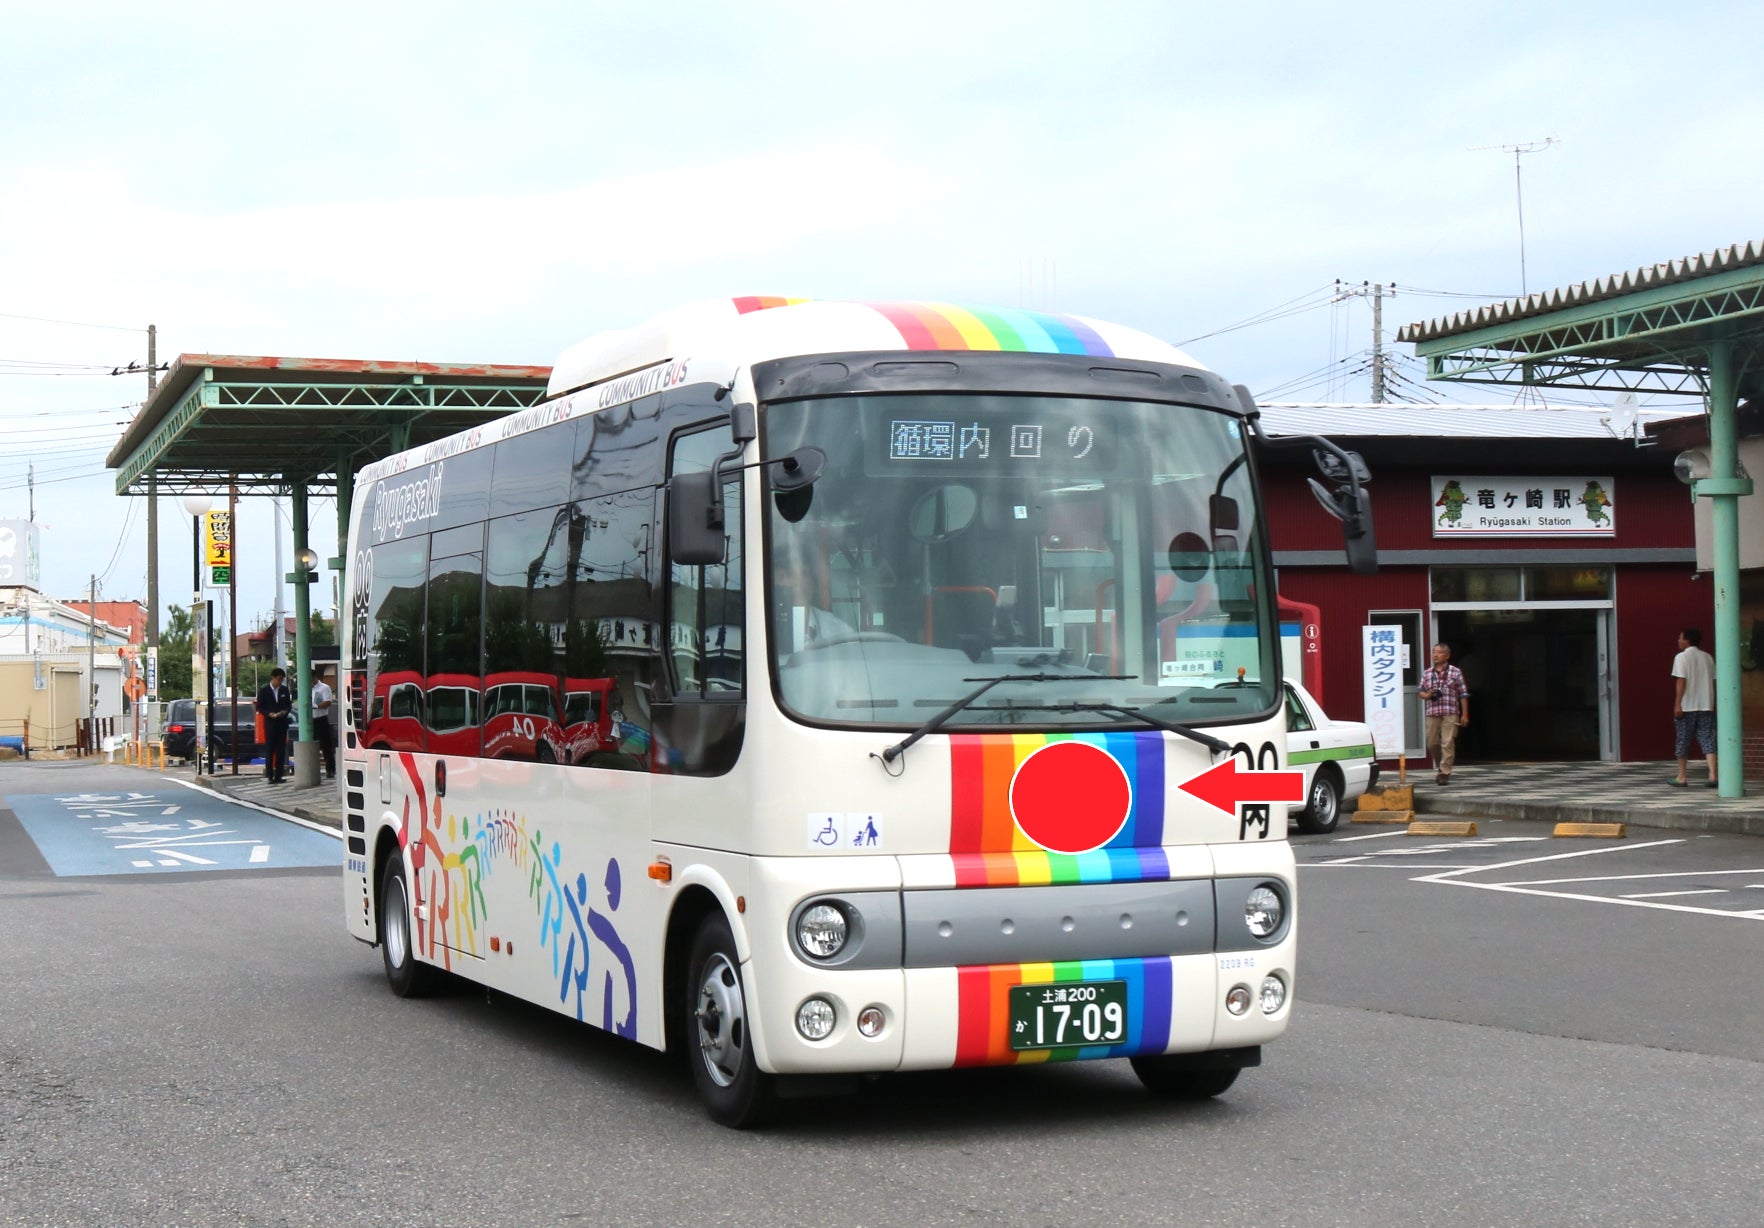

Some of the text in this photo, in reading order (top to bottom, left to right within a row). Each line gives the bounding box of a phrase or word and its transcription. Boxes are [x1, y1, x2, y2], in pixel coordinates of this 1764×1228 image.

[599, 358, 690, 408] COMMUNITY BUS
[465, 427, 483, 449] BUS
[501, 397, 575, 438] COMMUNITY BUS
[372, 461, 444, 542] Ryugasaki
[1538, 516, 1572, 526] Station
[1036, 1002, 1123, 1044] 17-09
